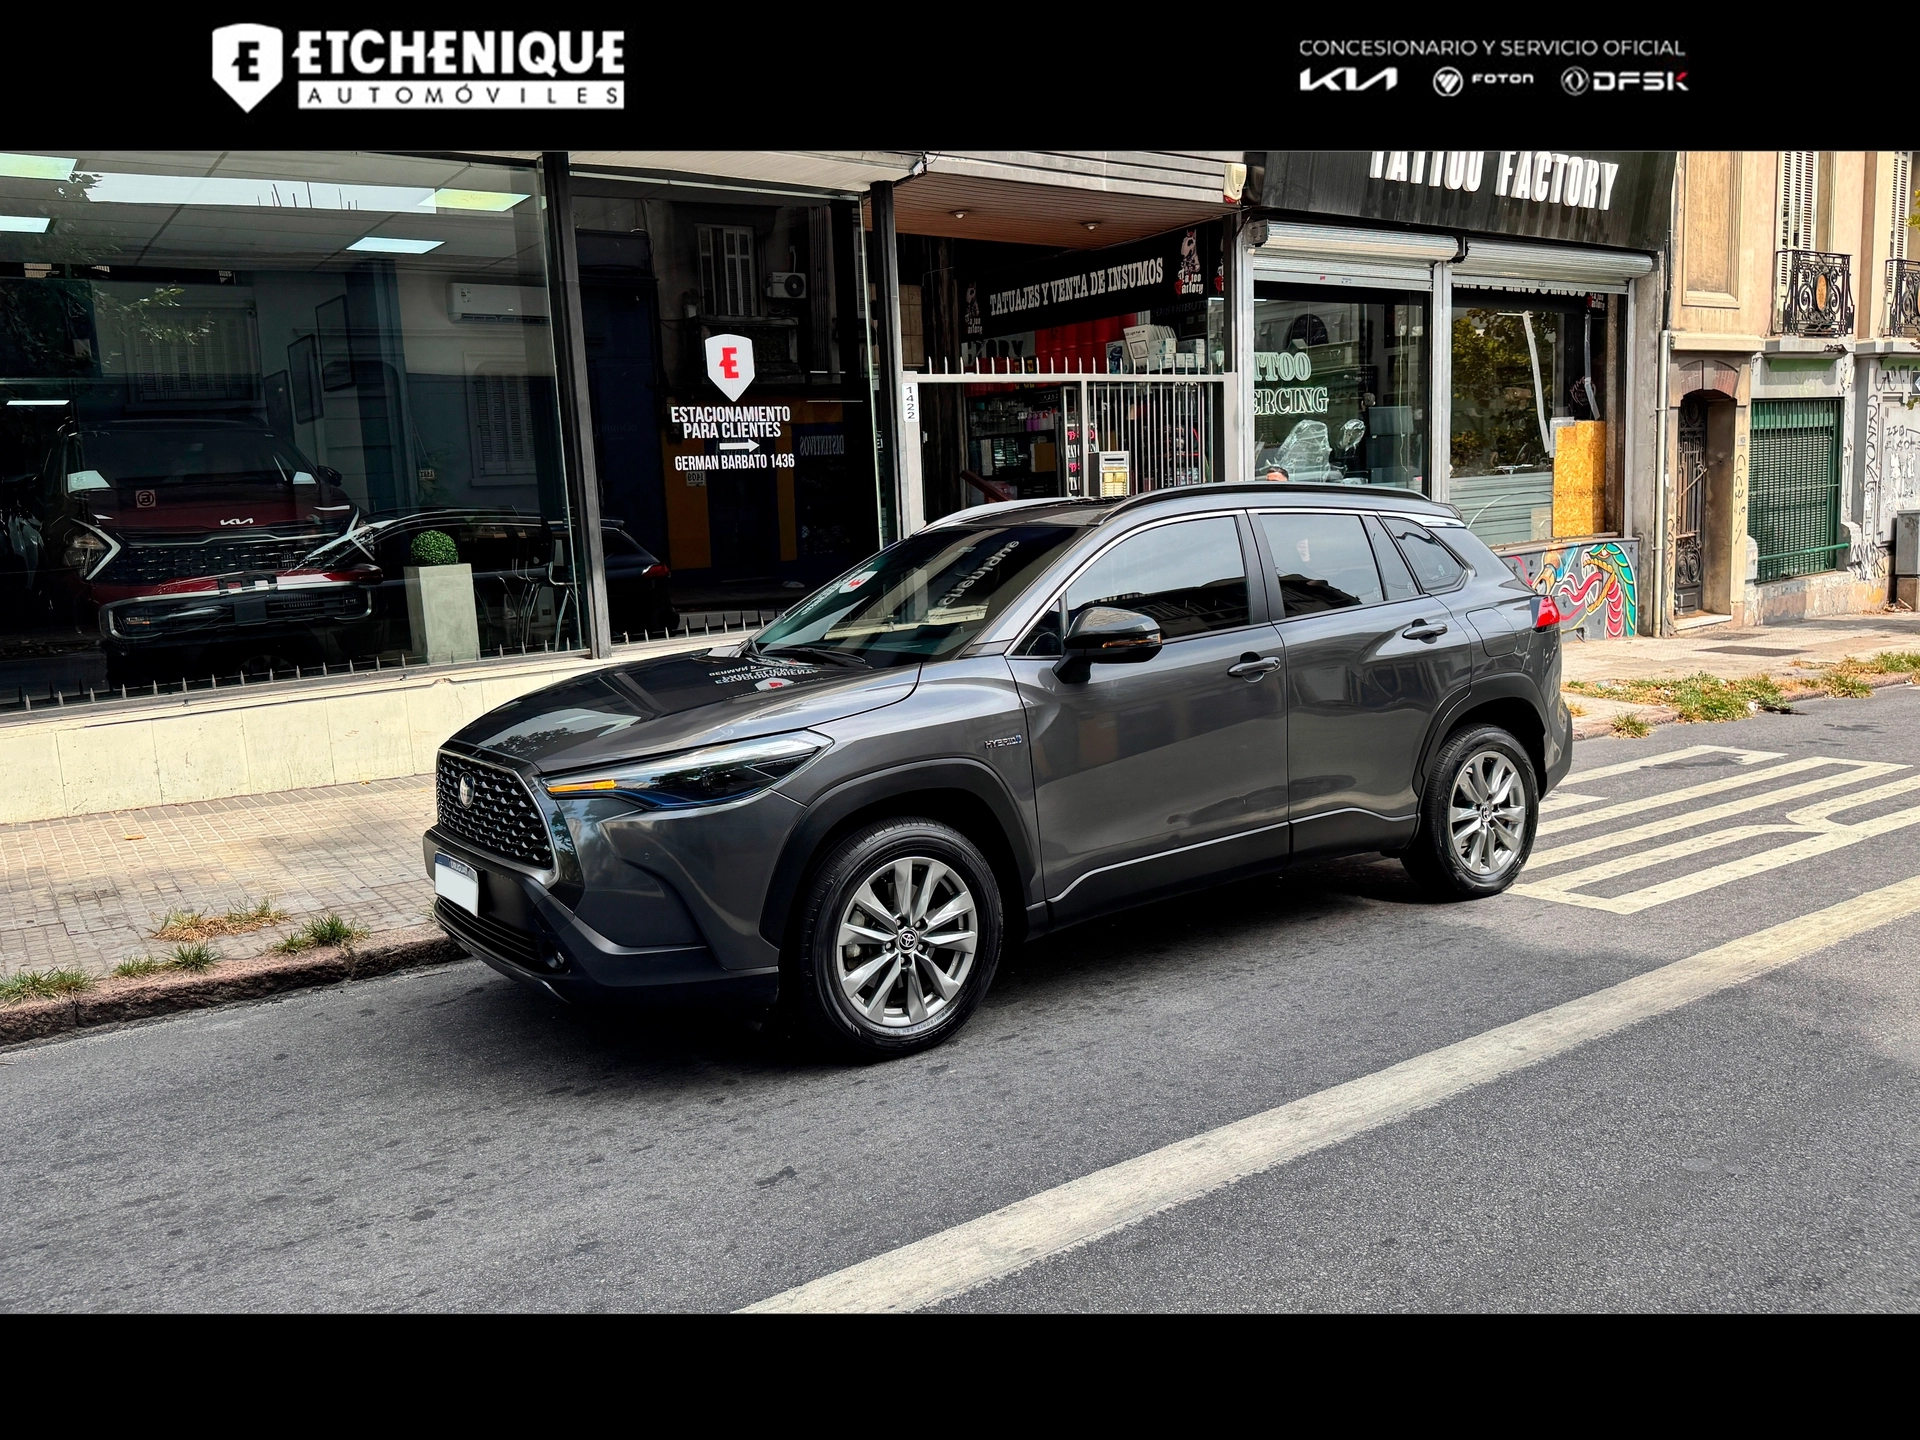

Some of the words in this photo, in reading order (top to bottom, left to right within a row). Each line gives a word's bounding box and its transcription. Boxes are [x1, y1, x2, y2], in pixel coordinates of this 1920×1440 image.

[1369, 151, 1485, 192] TATTOO
[1495, 151, 1619, 211] FACTORY
[990, 284, 1040, 316] TATUAJES
[1041, 282, 1050, 306] Y
[1050, 273, 1088, 304] VENTA
[1089, 269, 1106, 296] DE
[1107, 257, 1163, 292] INSUMOS
[670, 406, 791, 423] ESTACIONAMIENTO
[906, 386, 916, 420] 1422
[683, 422, 719, 439] PARA
[721, 421, 782, 438] CLIENTES
[674, 455, 719, 471] GERMAN
[721, 454, 768, 470] BARBATO
[770, 453, 795, 468] 1436
